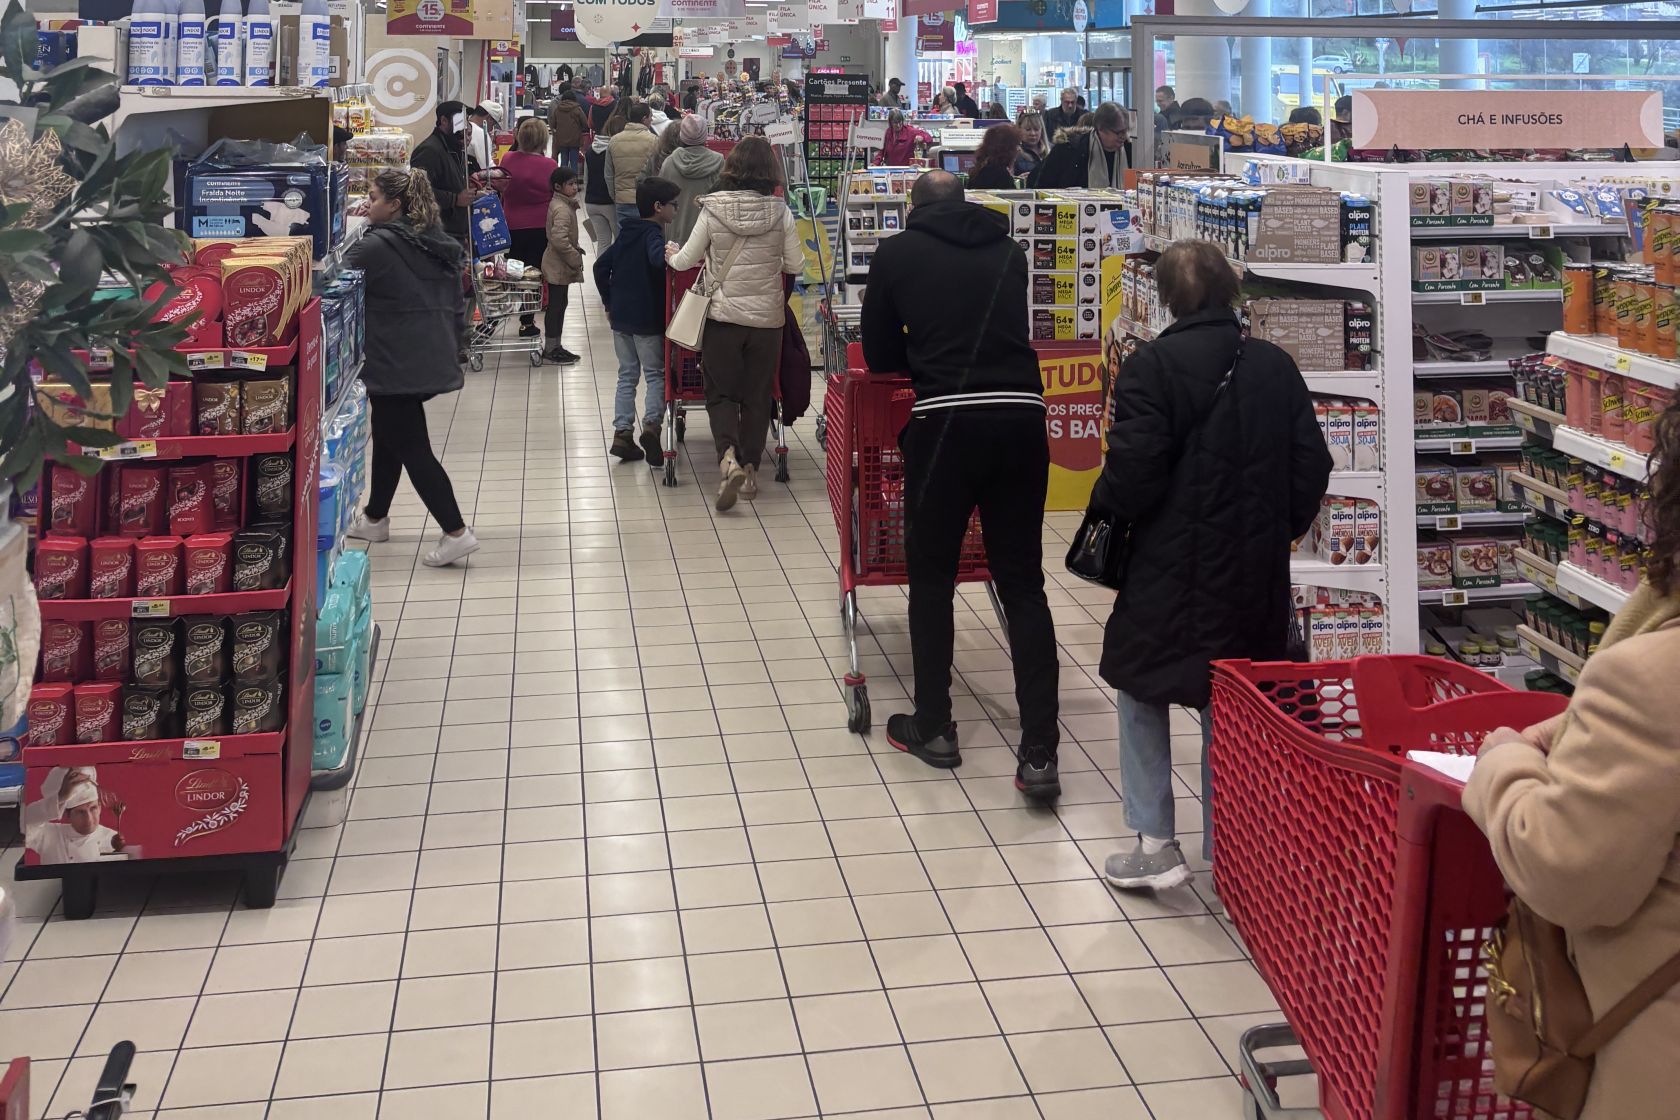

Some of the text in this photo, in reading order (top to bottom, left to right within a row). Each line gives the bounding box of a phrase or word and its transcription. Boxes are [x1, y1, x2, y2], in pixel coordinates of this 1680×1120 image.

[422, 3, 438, 16] 15
[886, 7, 895, 18] 11
[1458, 111, 1563, 125] CHÁ E INFUSÕES
[1348, 210, 1369, 221] alpro
[198, 219, 208, 227] M
[1057, 246, 1068, 254] 64
[1256, 244, 1291, 261] alpro
[1056, 281, 1067, 289] 64
[1056, 316, 1067, 324] 64
[1349, 318, 1370, 329] alpro
[1330, 420, 1350, 429] alpro
[1357, 419, 1377, 428] alpro
[1331, 436, 1349, 445] SOJA
[1358, 436, 1376, 445] SOJA
[1332, 511, 1353, 521] alpro
[1358, 511, 1378, 521] alpro
[1312, 622, 1334, 631] alpro
[1337, 621, 1358, 630] alpro
[187, 791, 225, 802] LINDOR
